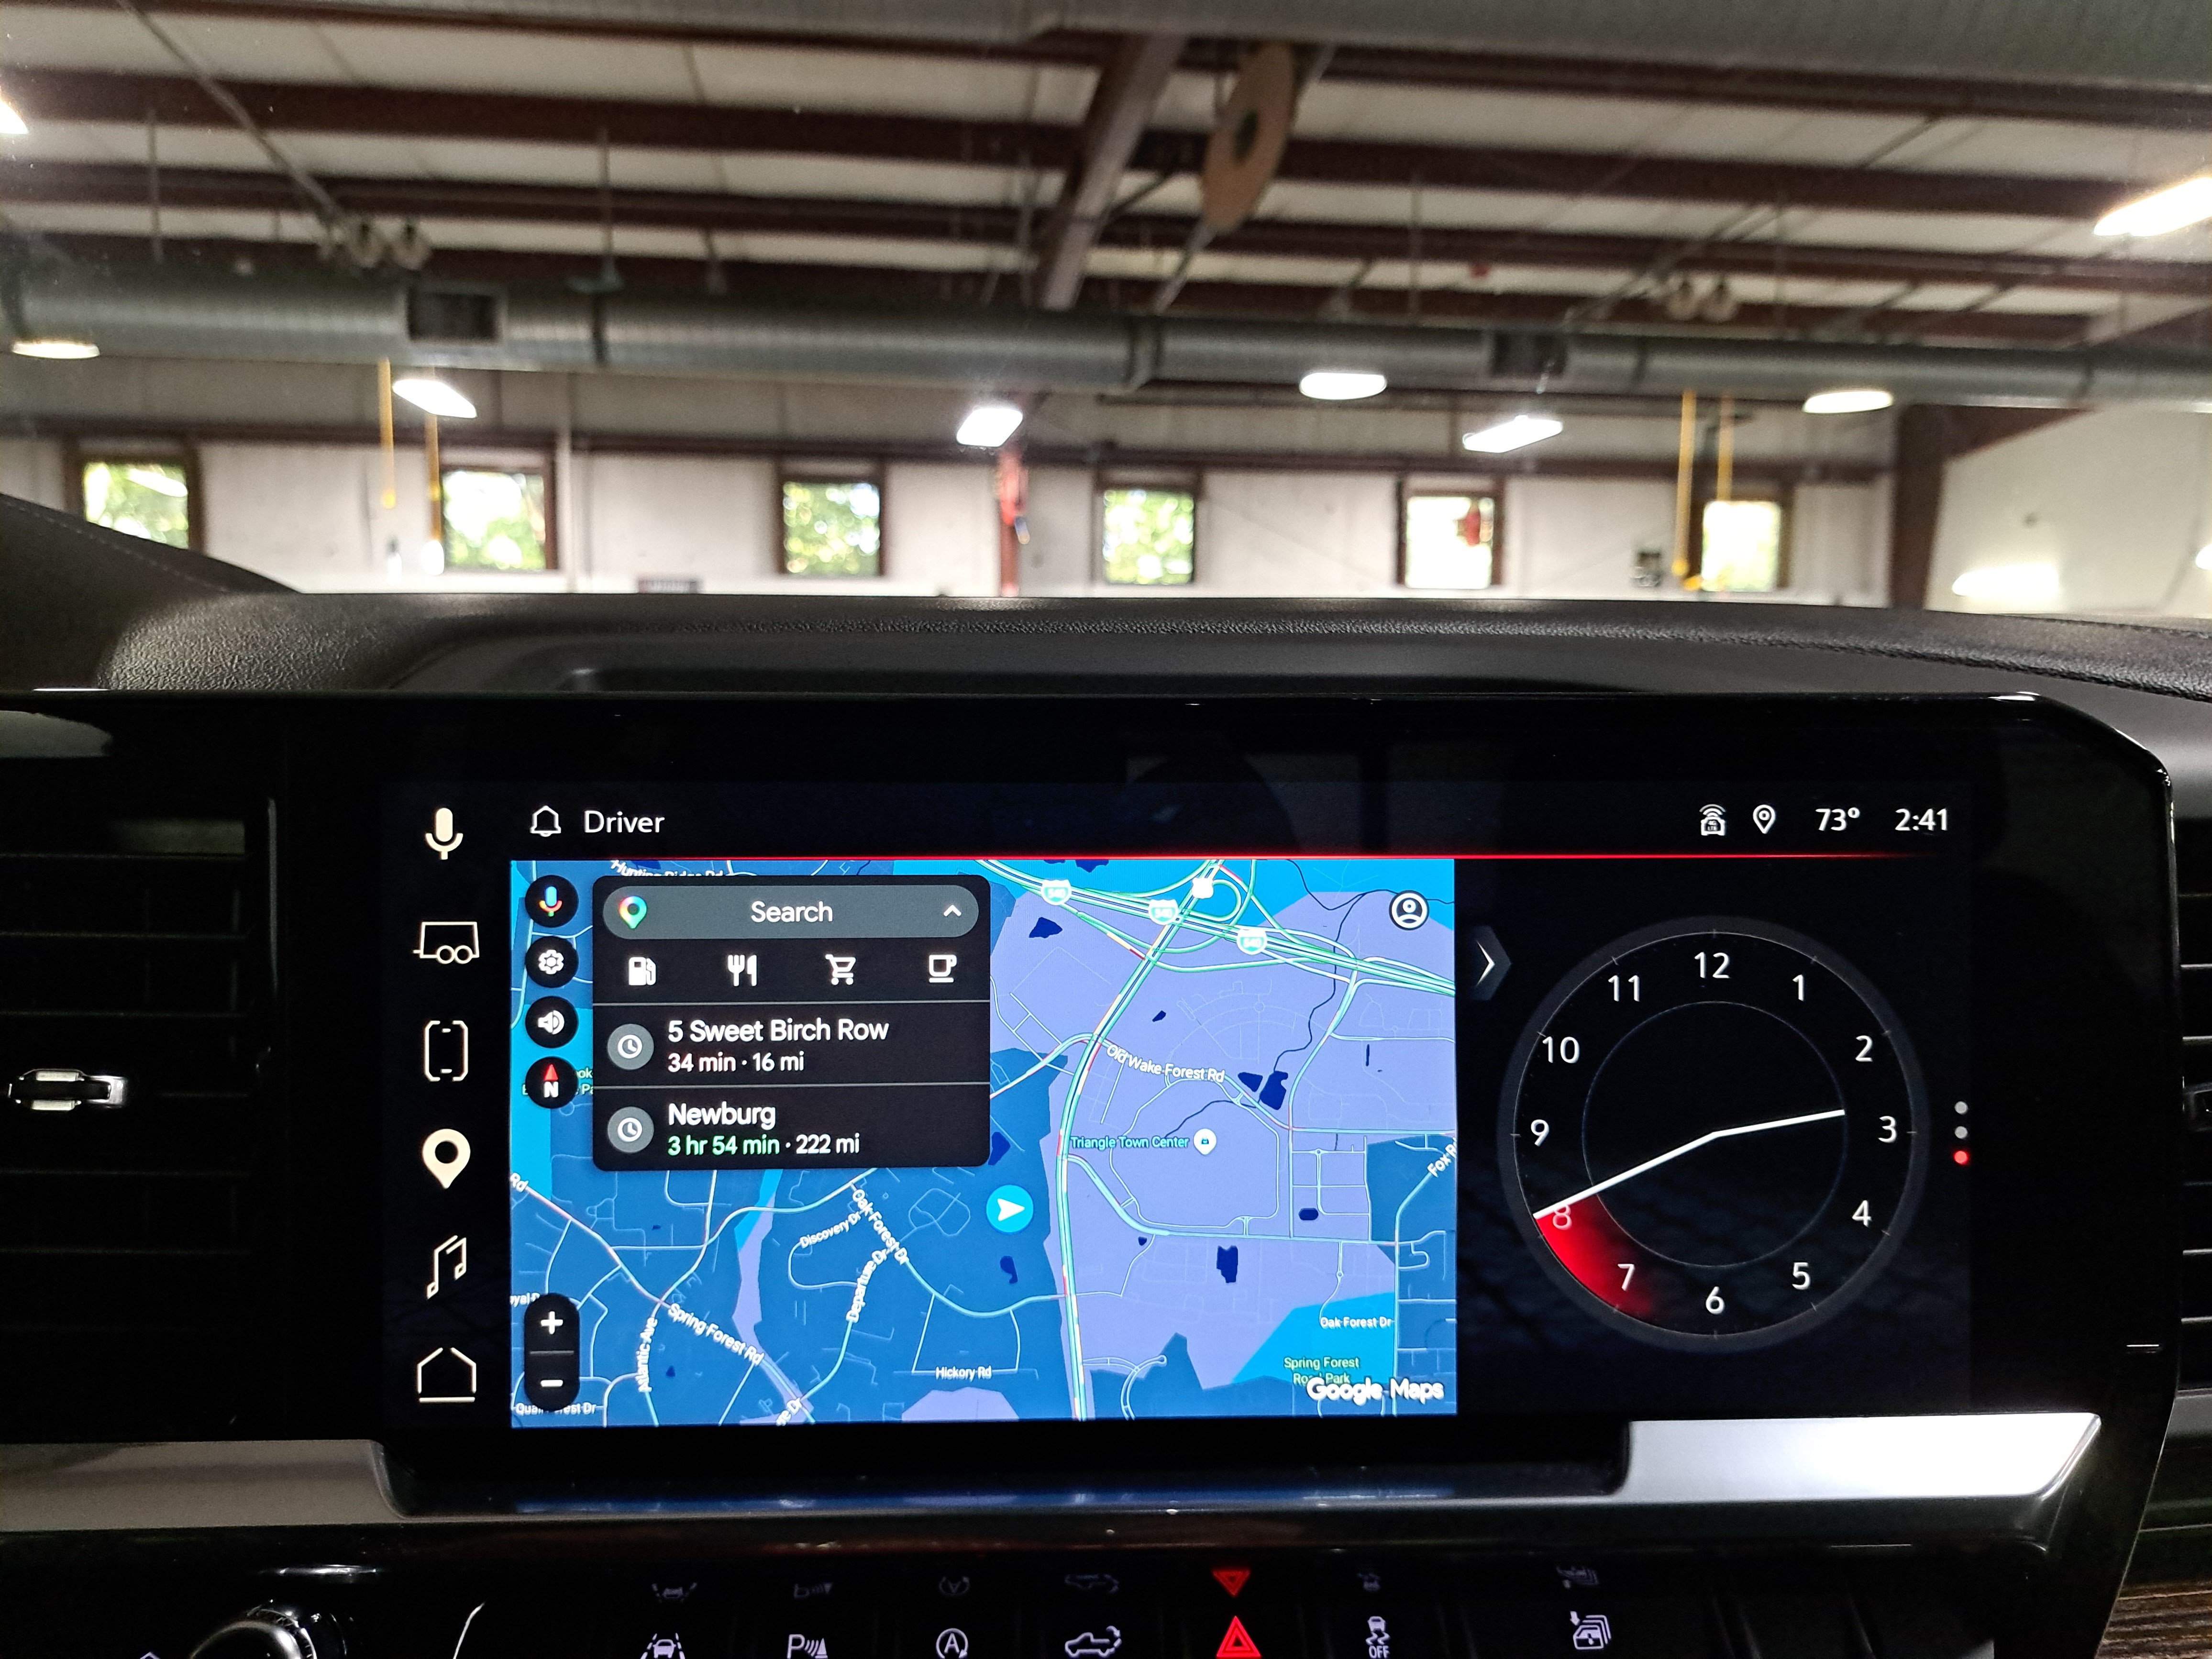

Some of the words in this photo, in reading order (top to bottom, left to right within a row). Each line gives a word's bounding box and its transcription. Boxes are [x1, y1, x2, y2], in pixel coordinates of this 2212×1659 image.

[584, 810, 665, 833] Driver
[1895, 808, 1947, 831] 2:41
[750, 900, 833, 923] Search
[1694, 951, 1730, 979] 12
[1608, 975, 1639, 1002] 11
[1792, 974, 1804, 1001] 1
[668, 1020, 684, 1042] 5
[690, 1019, 764, 1042] Sweet
[770, 1017, 830, 1041] Birch
[838, 1018, 889, 1040] Row
[668, 1052, 694, 1073] 34
[699, 1051, 736, 1072] min
[752, 1052, 775, 1072] 16
[780, 1051, 804, 1071] mi
[1542, 1036, 1580, 1063] 10
[1855, 1035, 1872, 1062] 2
[1106, 1044, 1128, 1064] Old
[1128, 1054, 1162, 1075] Wake
[1165, 1063, 1205, 1080] Forest
[1207, 1068, 1225, 1083] Rd
[543, 1081, 559, 1097] N
[668, 1101, 776, 1130] Newburg
[1071, 1136, 1116, 1150] Triangle
[1118, 1136, 1149, 1148] Town
[1152, 1136, 1190, 1148] Center
[1531, 1119, 1549, 1146] 9
[1878, 1116, 1897, 1143] 3
[668, 1136, 681, 1156] 3
[686, 1134, 708, 1155] hr
[712, 1135, 738, 1155] 54
[743, 1134, 780, 1155] min
[796, 1134, 831, 1154] 222
[836, 1132, 860, 1153] mi
[1427, 1154, 1452, 1178] Fox
[510, 1172, 529, 1192] Rd
[852, 1189, 874, 1217] Oak
[868, 1211, 900, 1251] Forest
[894, 1247, 909, 1265] Dr
[1552, 1204, 1572, 1231] 8
[1852, 1200, 1871, 1227] 4
[799, 1219, 849, 1249] Discovery
[848, 1211, 861, 1226] Dr
[845, 1260, 877, 1323] Departure
[872, 1249, 887, 1265] Dr
[1617, 1263, 1635, 1291] 7
[1792, 1262, 1811, 1290] 5
[1705, 1286, 1725, 1315] 6
[640, 1317, 658, 1344] Ave
[668, 1303, 707, 1335] Spring
[706, 1323, 745, 1356] Forest
[744, 1345, 764, 1365] Rd
[1320, 1316, 1341, 1329] Oak
[1343, 1316, 1377, 1329] Forest
[1379, 1316, 1392, 1327] Dr
[635, 1343, 653, 1392] Atlantic
[936, 1366, 975, 1382] Hickory
[978, 1365, 992, 1380] Rd
[1283, 1357, 1320, 1370] Spring
[1323, 1357, 1360, 1369] Forest
[1306, 1377, 1383, 1406] Google
[1390, 1378, 1444, 1405] Maps
[583, 1402, 597, 1415] Dr
[787, 1398, 802, 1415] Dr
[1369, 1645, 1390, 1659] OFF
